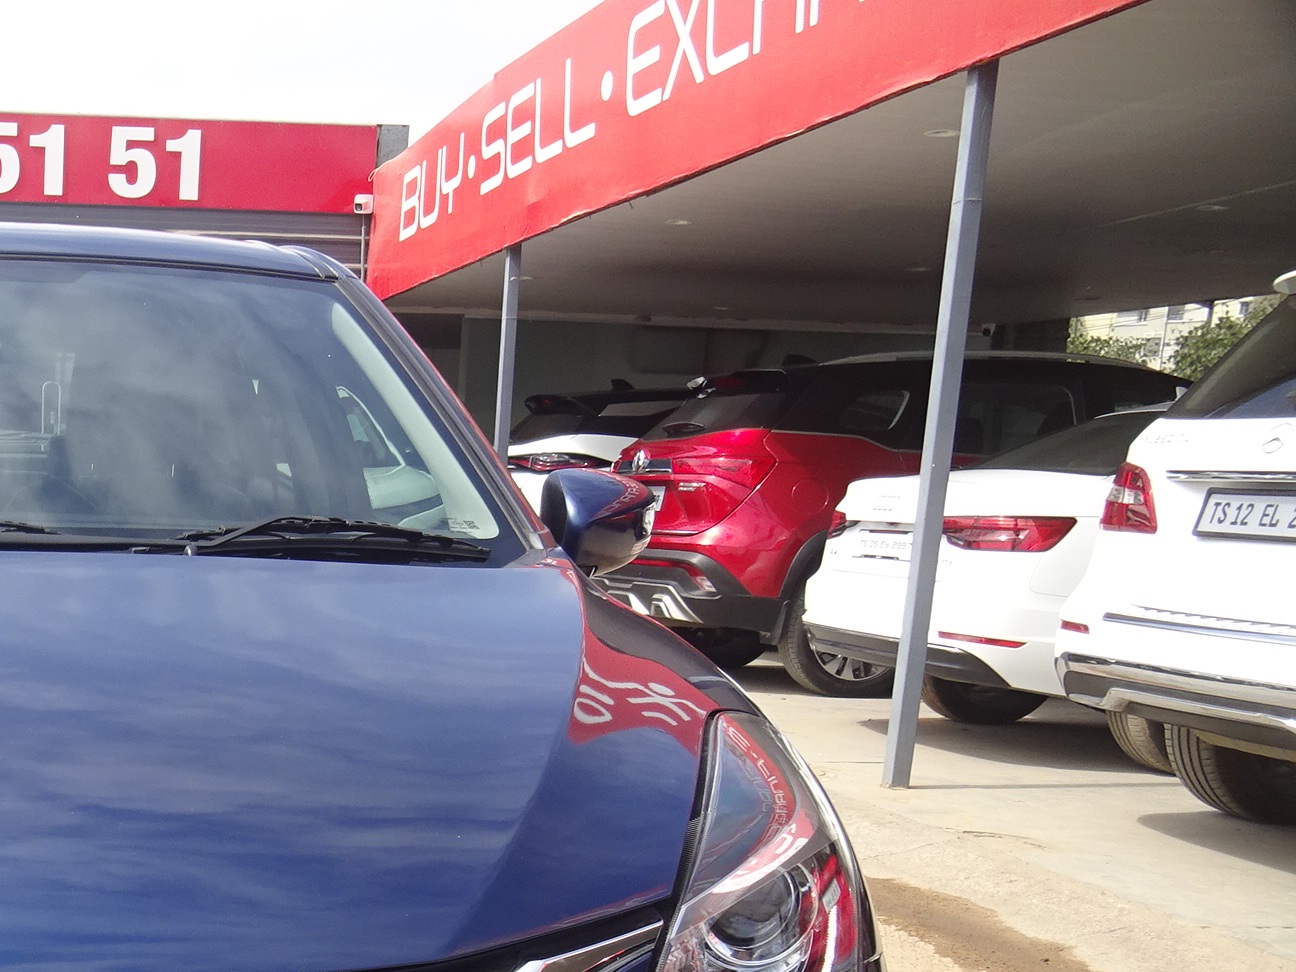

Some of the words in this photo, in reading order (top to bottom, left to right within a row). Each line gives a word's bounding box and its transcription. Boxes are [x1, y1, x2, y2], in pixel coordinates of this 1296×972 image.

[398, 133, 465, 242] BUY
[480, 57, 596, 196] SELL
[625, 0, 866, 117] EXC
[108, 126, 202, 201] 51
[1209, 502, 1231, 525] TS
[1230, 503, 1255, 526] 12
[1258, 504, 1280, 528] EL
